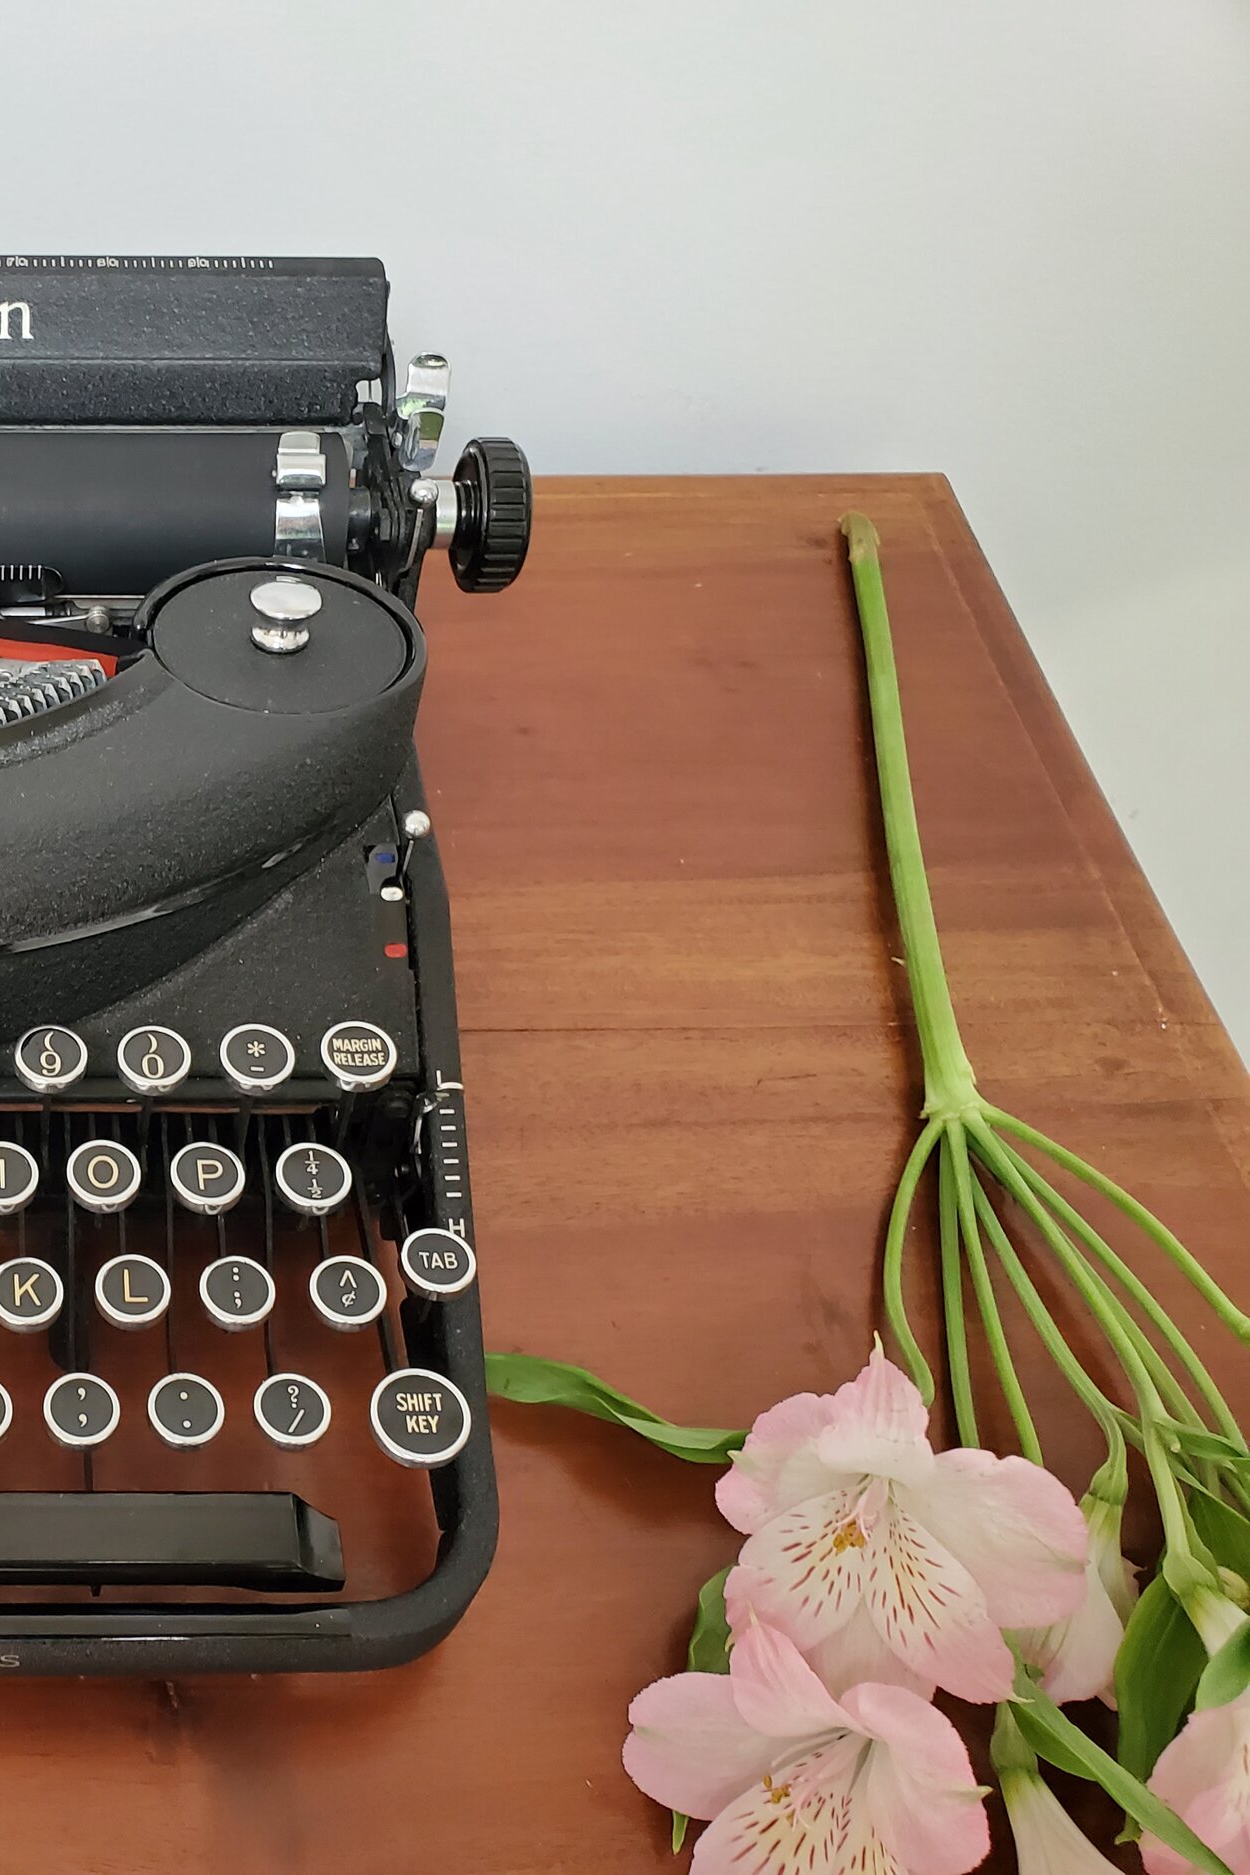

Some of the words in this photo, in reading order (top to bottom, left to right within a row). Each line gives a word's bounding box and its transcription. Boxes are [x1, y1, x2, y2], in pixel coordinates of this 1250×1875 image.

[331, 1037, 383, 1052] MARGIN
[39, 1051, 62, 1077] 9
[333, 1052, 387, 1067] RELEASE
[0, 1158, 6, 1189] I
[87, 1155, 119, 1189] O
[196, 1159, 224, 1191] P
[448, 1219, 465, 1238] H
[418, 1251, 458, 1269] TAB
[13, 1273, 42, 1307] K
[123, 1268, 149, 1303] L
[287, 1385, 300, 1409] ?
[396, 1392, 442, 1412] SHIFT
[405, 1414, 439, 1434] KEY
